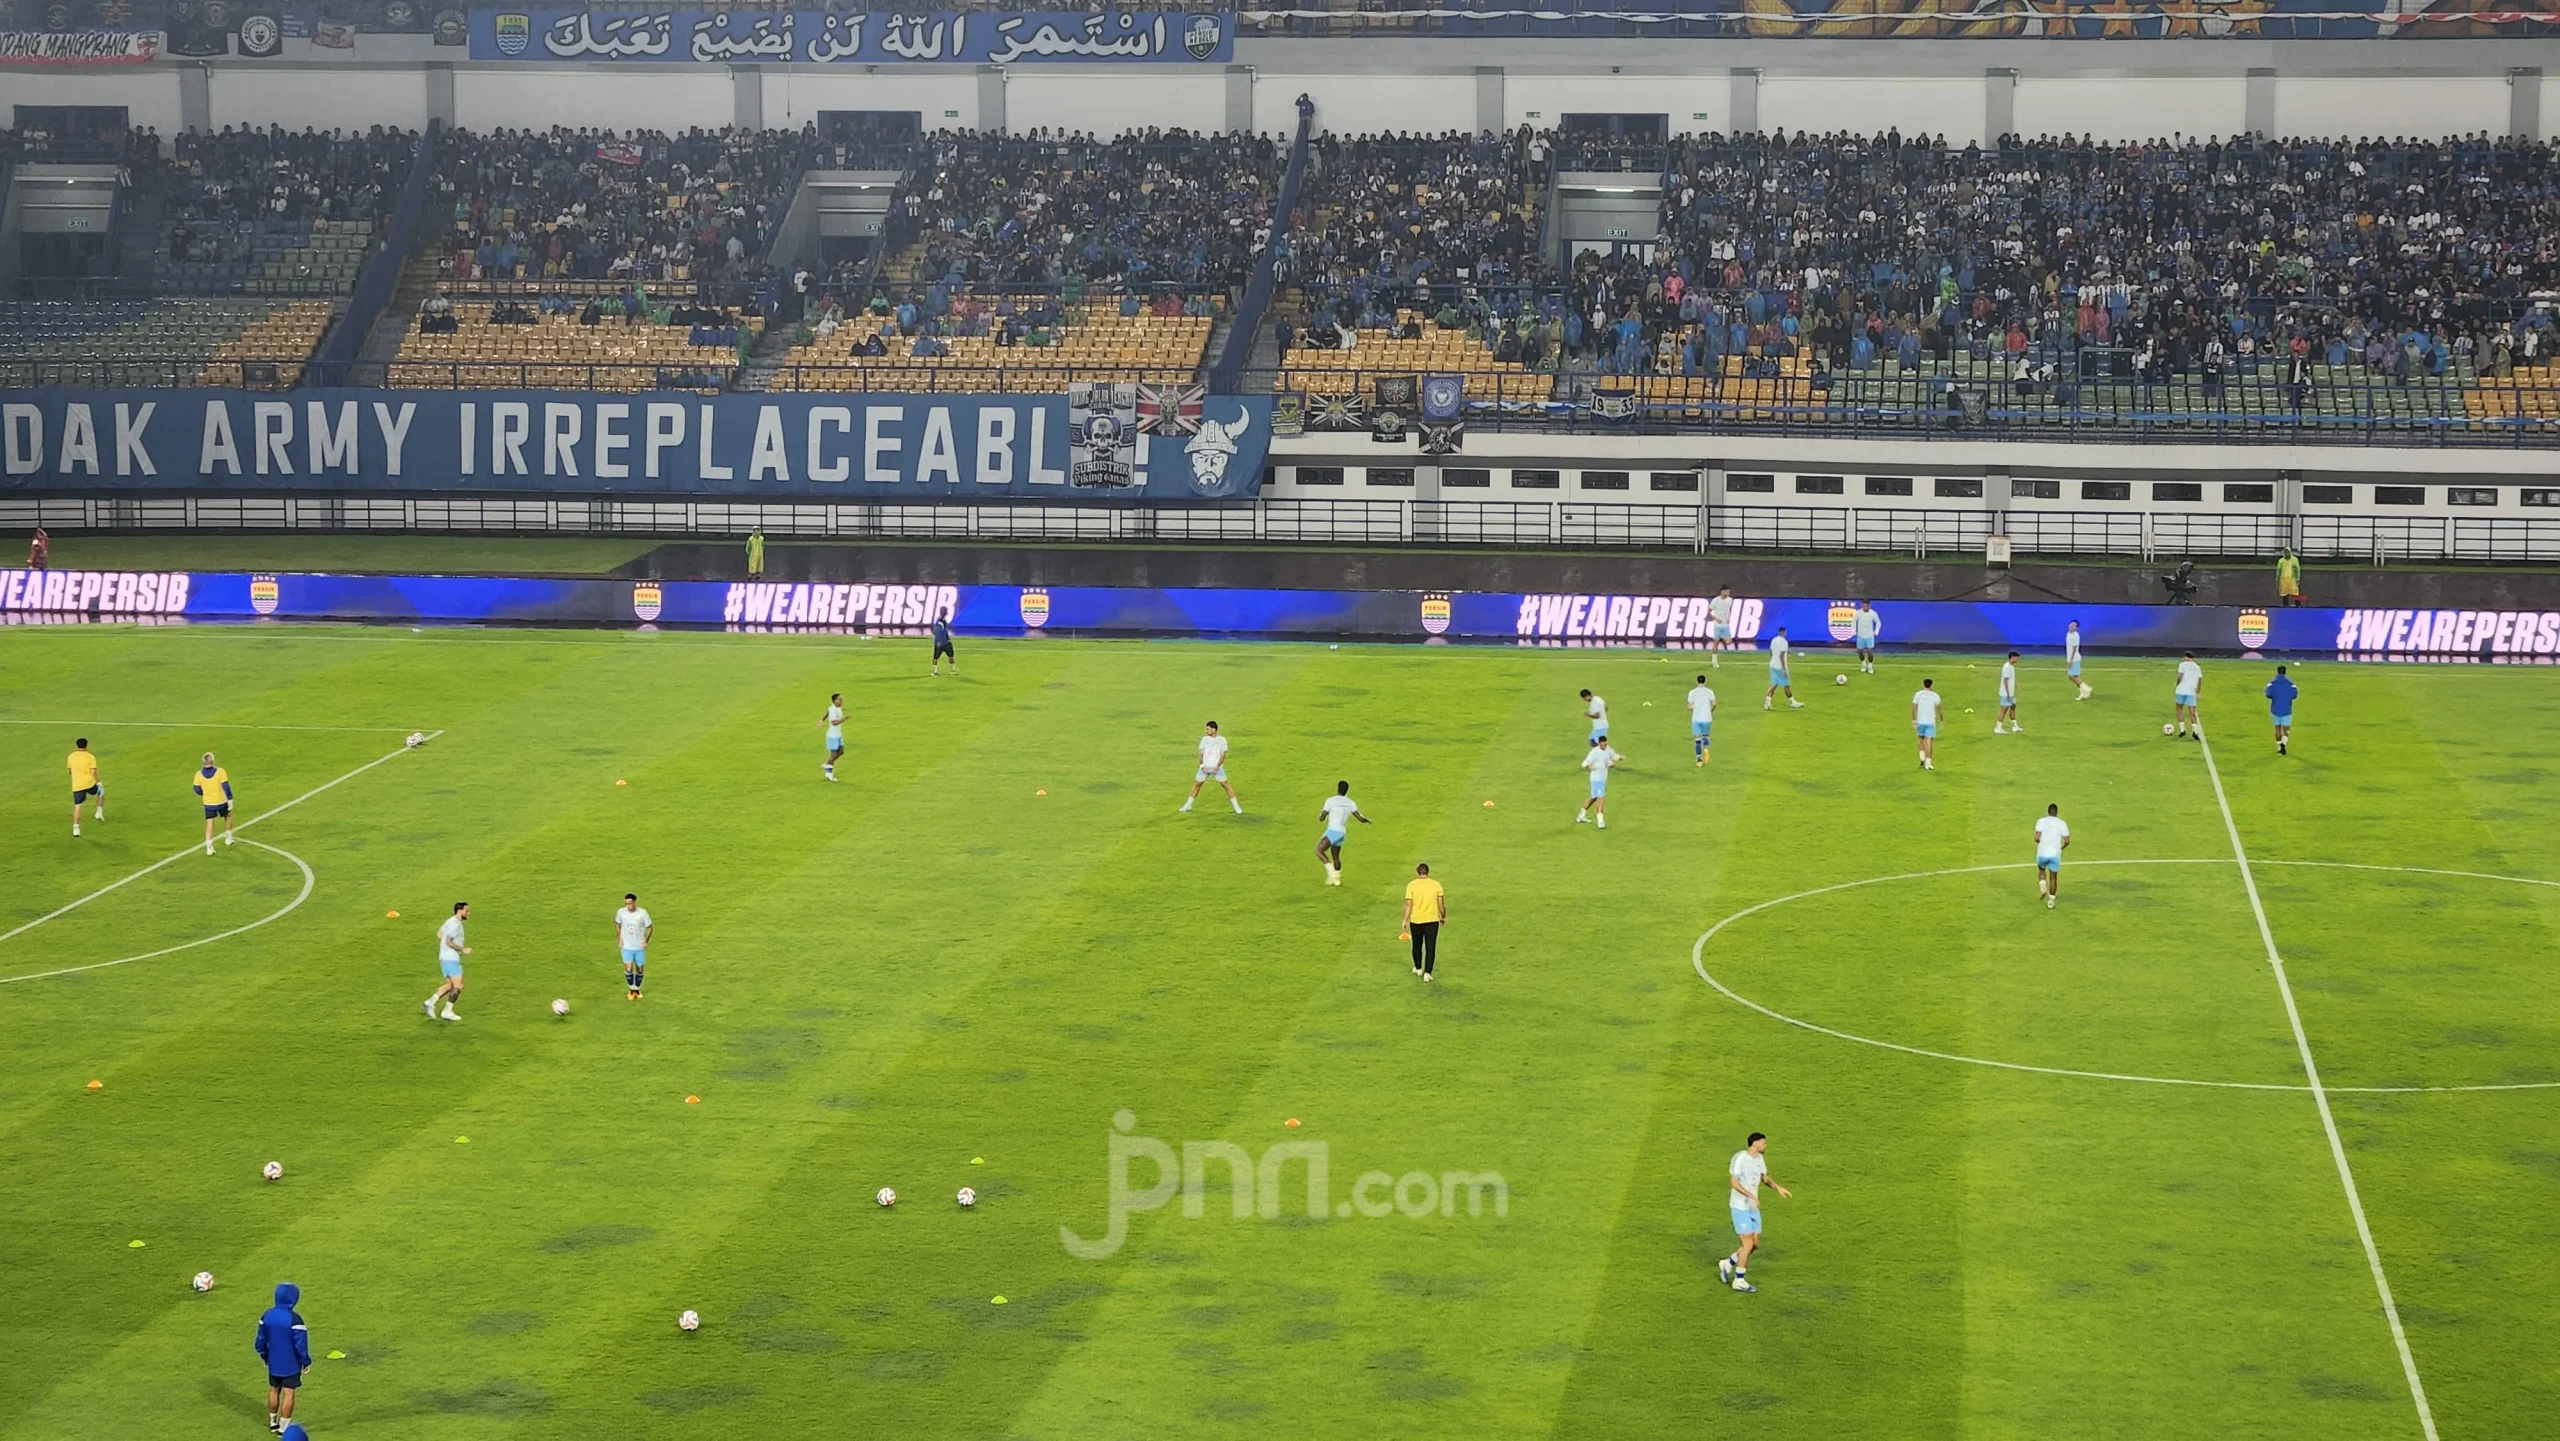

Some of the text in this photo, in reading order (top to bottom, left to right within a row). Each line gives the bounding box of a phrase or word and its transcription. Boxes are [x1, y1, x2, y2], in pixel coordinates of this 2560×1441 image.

[1607, 229, 1627, 237] EXIT
[3, 402, 158, 476] DAK
[200, 400, 416, 476] ARMY
[1074, 460, 1129, 475] SUBDISTRIK
[724, 583, 958, 624] #WEAREPERSIB
[1517, 595, 1763, 639] #WEAREPERIB
[2336, 609, 2560, 653] #WEAREPERS
